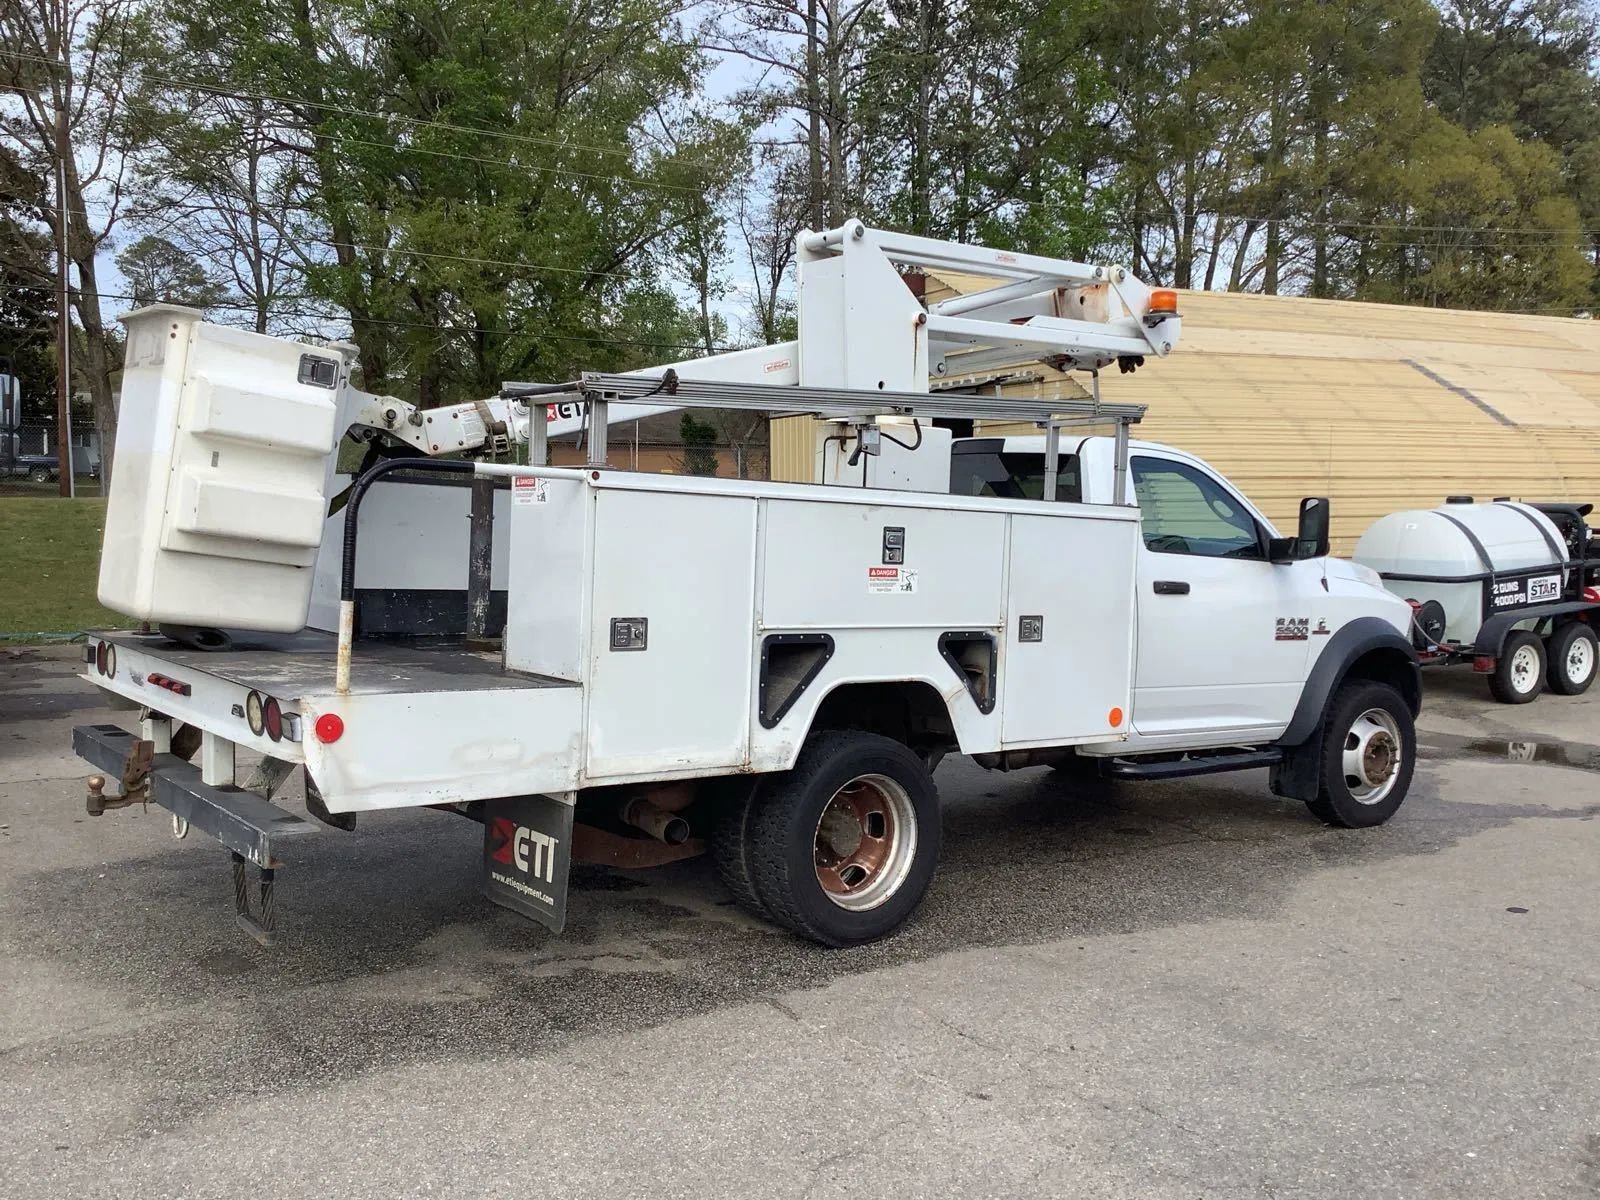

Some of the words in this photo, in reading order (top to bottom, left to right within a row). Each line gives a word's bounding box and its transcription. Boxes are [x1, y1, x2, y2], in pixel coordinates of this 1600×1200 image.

[876, 569, 896, 577] DANGER
[1493, 585, 1499, 594] 2
[1500, 581, 1519, 593] GUNS
[1531, 582, 1557, 595] STAR
[1494, 596, 1514, 606] 4000
[1514, 593, 1526, 604] PSI
[1276, 618, 1309, 626] RAM
[514, 826, 555, 883] ETI
[492, 871, 554, 906] www.etiequipment.com
